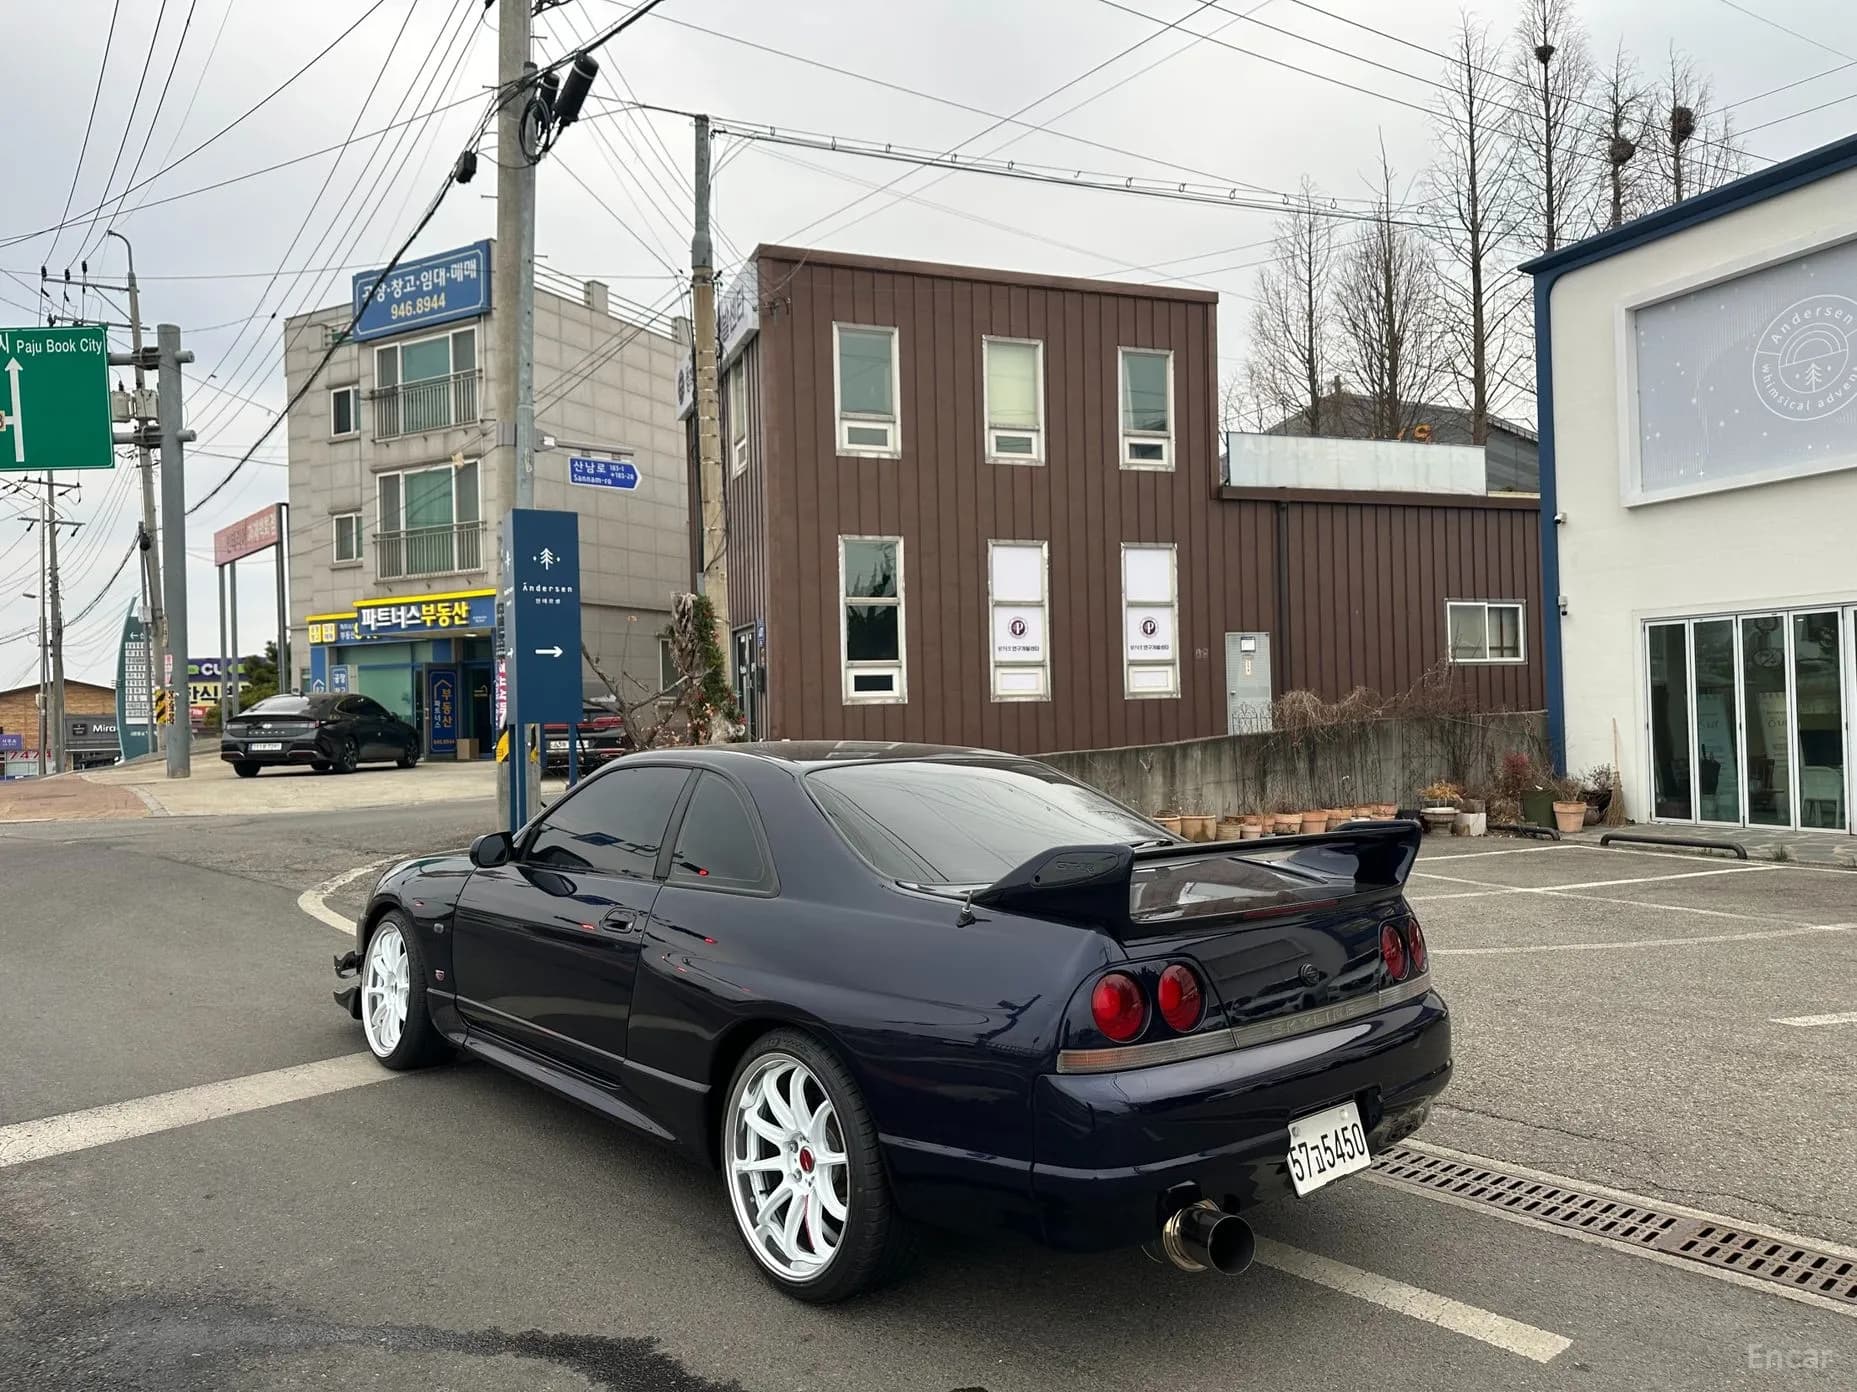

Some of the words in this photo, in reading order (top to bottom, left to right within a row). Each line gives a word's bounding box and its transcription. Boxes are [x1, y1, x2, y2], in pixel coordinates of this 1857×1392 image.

[391, 293, 446, 320] 946.8944
[1771, 306, 1853, 344] Andersen
[16, 339, 42, 357] Paju
[46, 338, 76, 353] Book
[80, 338, 103, 355] City
[1762, 363, 1810, 411] whimsical
[573, 474, 612, 485] Sannam-ro
[574, 461, 606, 474] 산남로
[361, 601, 470, 631] 파트너스부동산
[201, 663, 222, 676] CU
[1290, 1123, 1366, 1182] 57고5450
